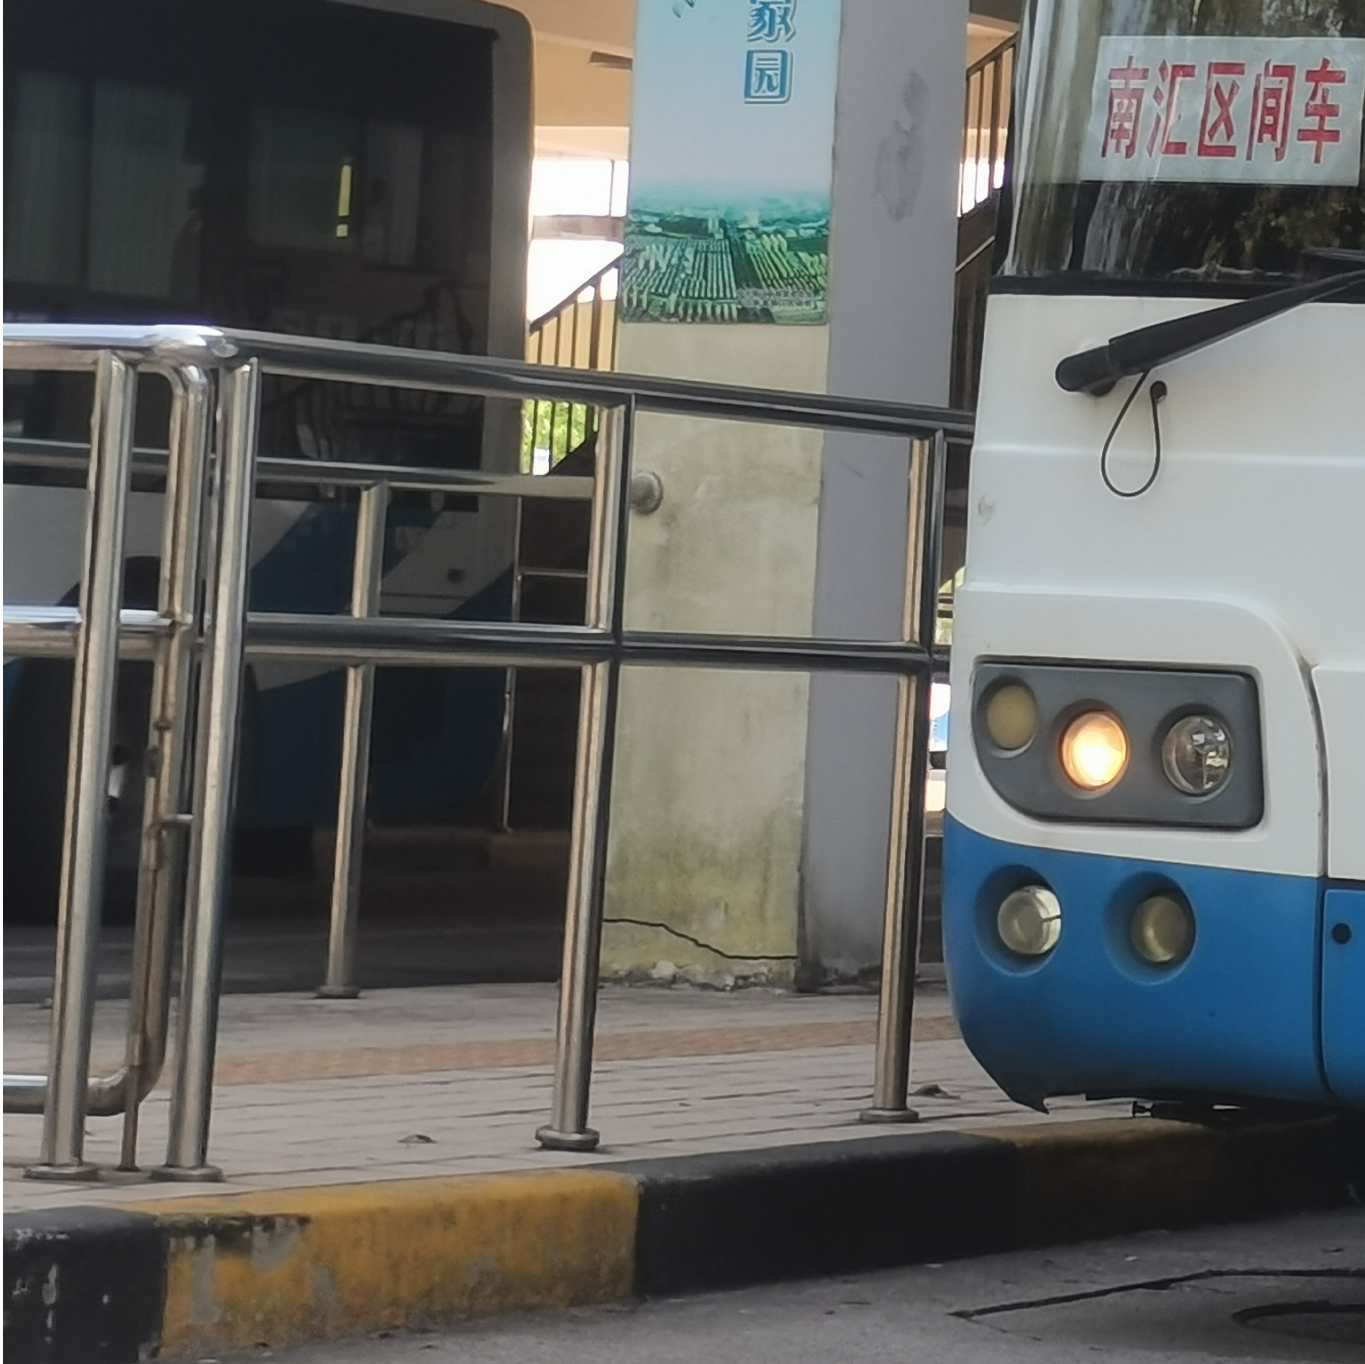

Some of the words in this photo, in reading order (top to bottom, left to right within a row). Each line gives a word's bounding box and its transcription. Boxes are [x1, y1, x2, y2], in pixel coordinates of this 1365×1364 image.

[1101, 55, 1347, 164] 南汇区间车
